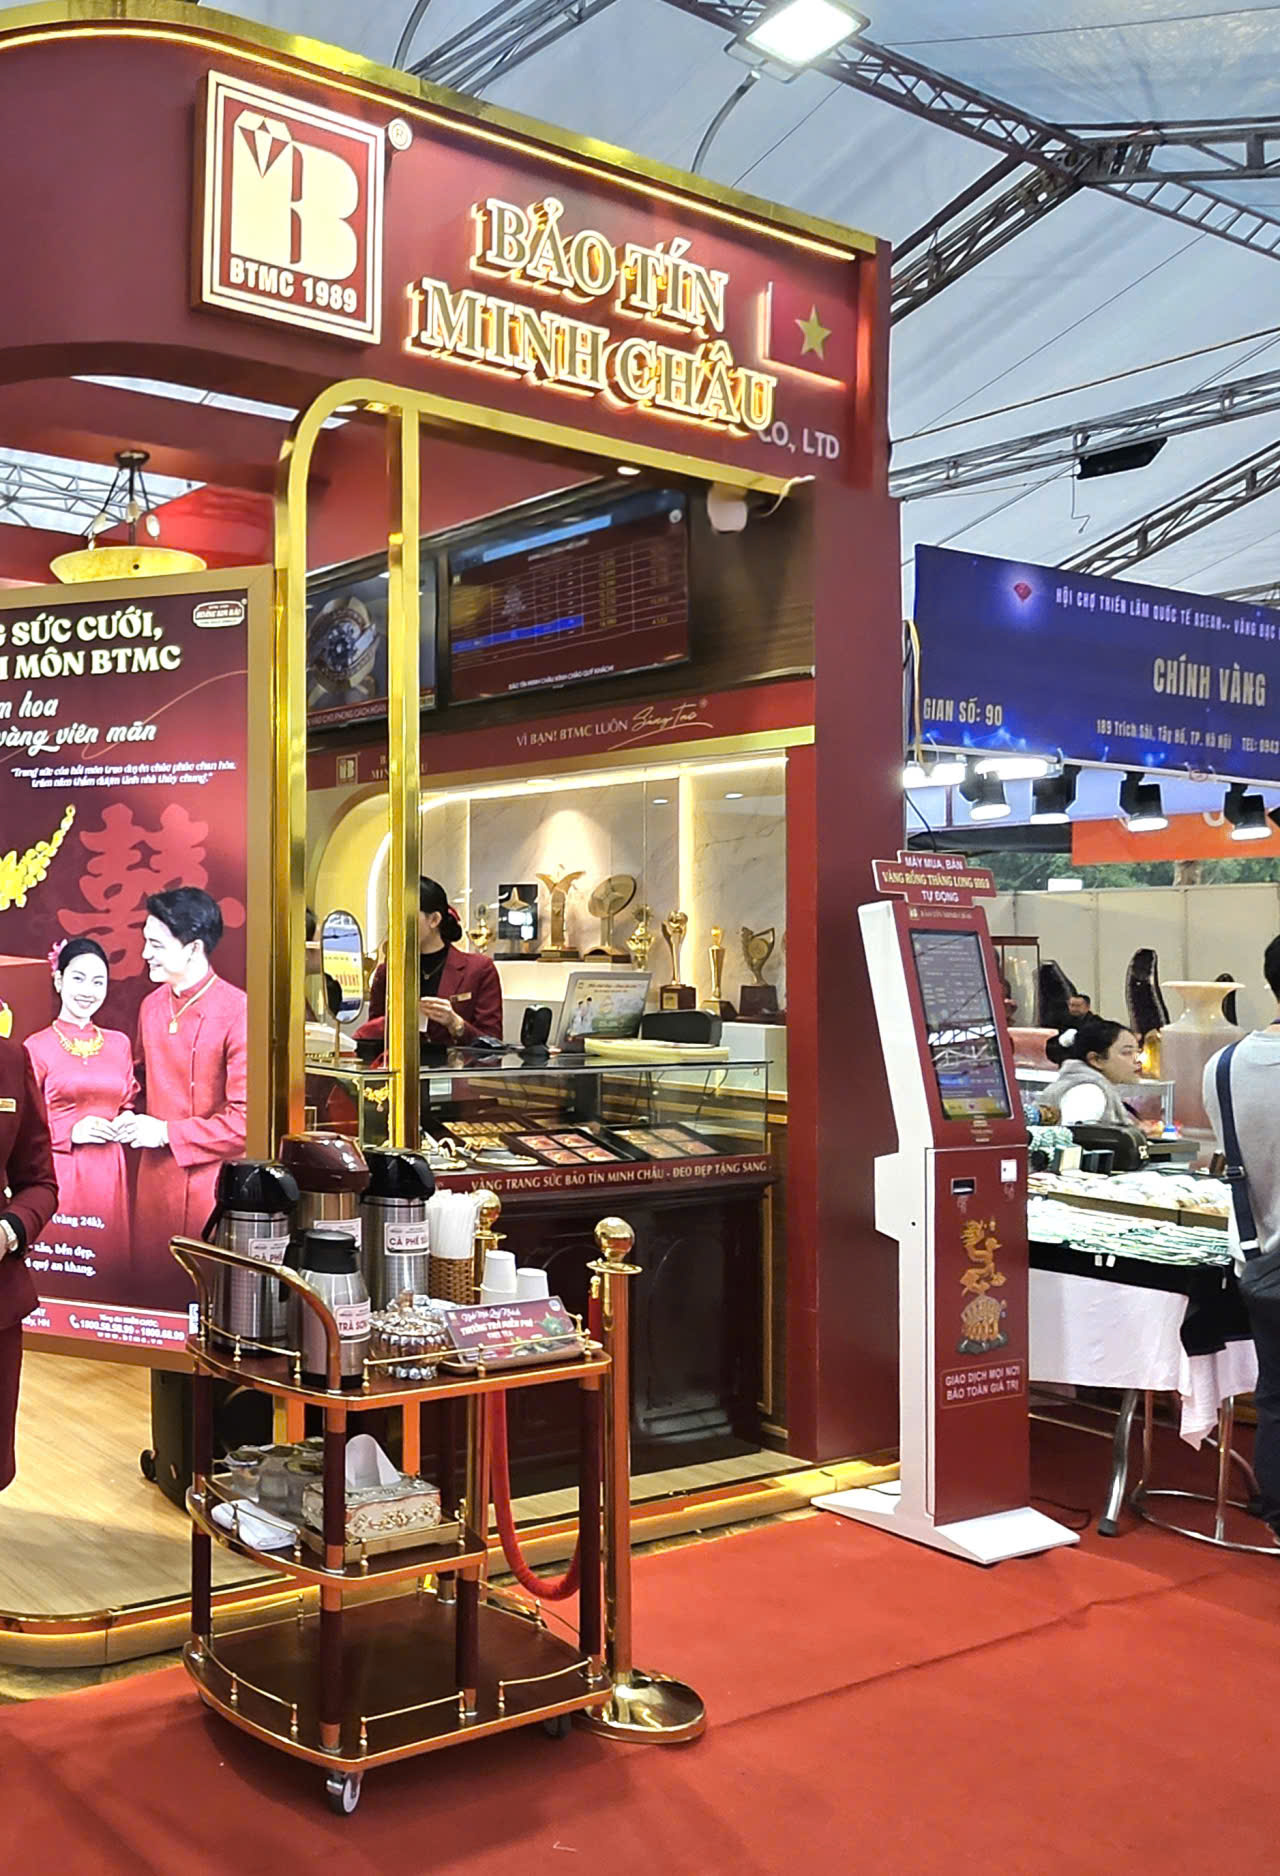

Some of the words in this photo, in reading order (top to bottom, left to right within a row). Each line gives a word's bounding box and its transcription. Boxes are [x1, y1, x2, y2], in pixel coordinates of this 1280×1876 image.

[477, 197, 616, 298] BẢO
[626, 237, 728, 333] TÍN
[229, 256, 295, 298] BTMC
[302, 277, 358, 313] 1989
[418, 280, 609, 391] MINH
[618, 342, 778, 433] CHÂU
[803, 427, 840, 460] LTD
[1056, 586, 1073, 608] HỘI
[1077, 591, 1095, 612] CHỢ
[11, 613, 73, 647] SỨC
[76, 606, 163, 642] CƯỚI,
[15, 648, 84, 680] MÔN
[90, 645, 182, 676] BTMC
[1153, 653, 1210, 700] CHÍNH
[1219, 662, 1267, 707] VÀNG
[19, 690, 60, 719] hoa
[923, 698, 954, 723] GIAN
[959, 697, 981, 724] SỐ:
[985, 704, 1003, 727] 90
[57, 722, 98, 747] viên
[106, 721, 157, 743] mãn
[530, 730, 557, 746] BẠN!
[559, 724, 593, 741] BTMC
[595, 718, 628, 736] LUÔN
[1096, 719, 1112, 735] 189
[1114, 720, 1137, 738] Trích
[1190, 731, 1204, 746] TP.
[921, 890, 934, 902] TỰ
[935, 891, 959, 903] ĐỘNG
[471, 1176, 503, 1192] VÀNG
[505, 1176, 540, 1190] TRANG
[543, 1170, 563, 1188] SỨC
[565, 1171, 586, 1186] BẢO
[588, 1168, 605, 1184] TÍN
[607, 1169, 635, 1183] MINH
[637, 1165, 664, 1181] CHÂU
[673, 1165, 692, 1178] ĐEO
[694, 1164, 713, 1179] ĐẸP
[715, 1161, 741, 1176] TẶNG
[742, 1161, 768, 1174] SANG
[390, 1235, 403, 1246] CÀ
[945, 1374, 966, 1386] GIAO
[989, 1367, 1004, 1379] MỌI
[947, 1387, 965, 1400] BẢO
[966, 1383, 989, 1397] TOÀN
[990, 1380, 1004, 1393] GIÁ
